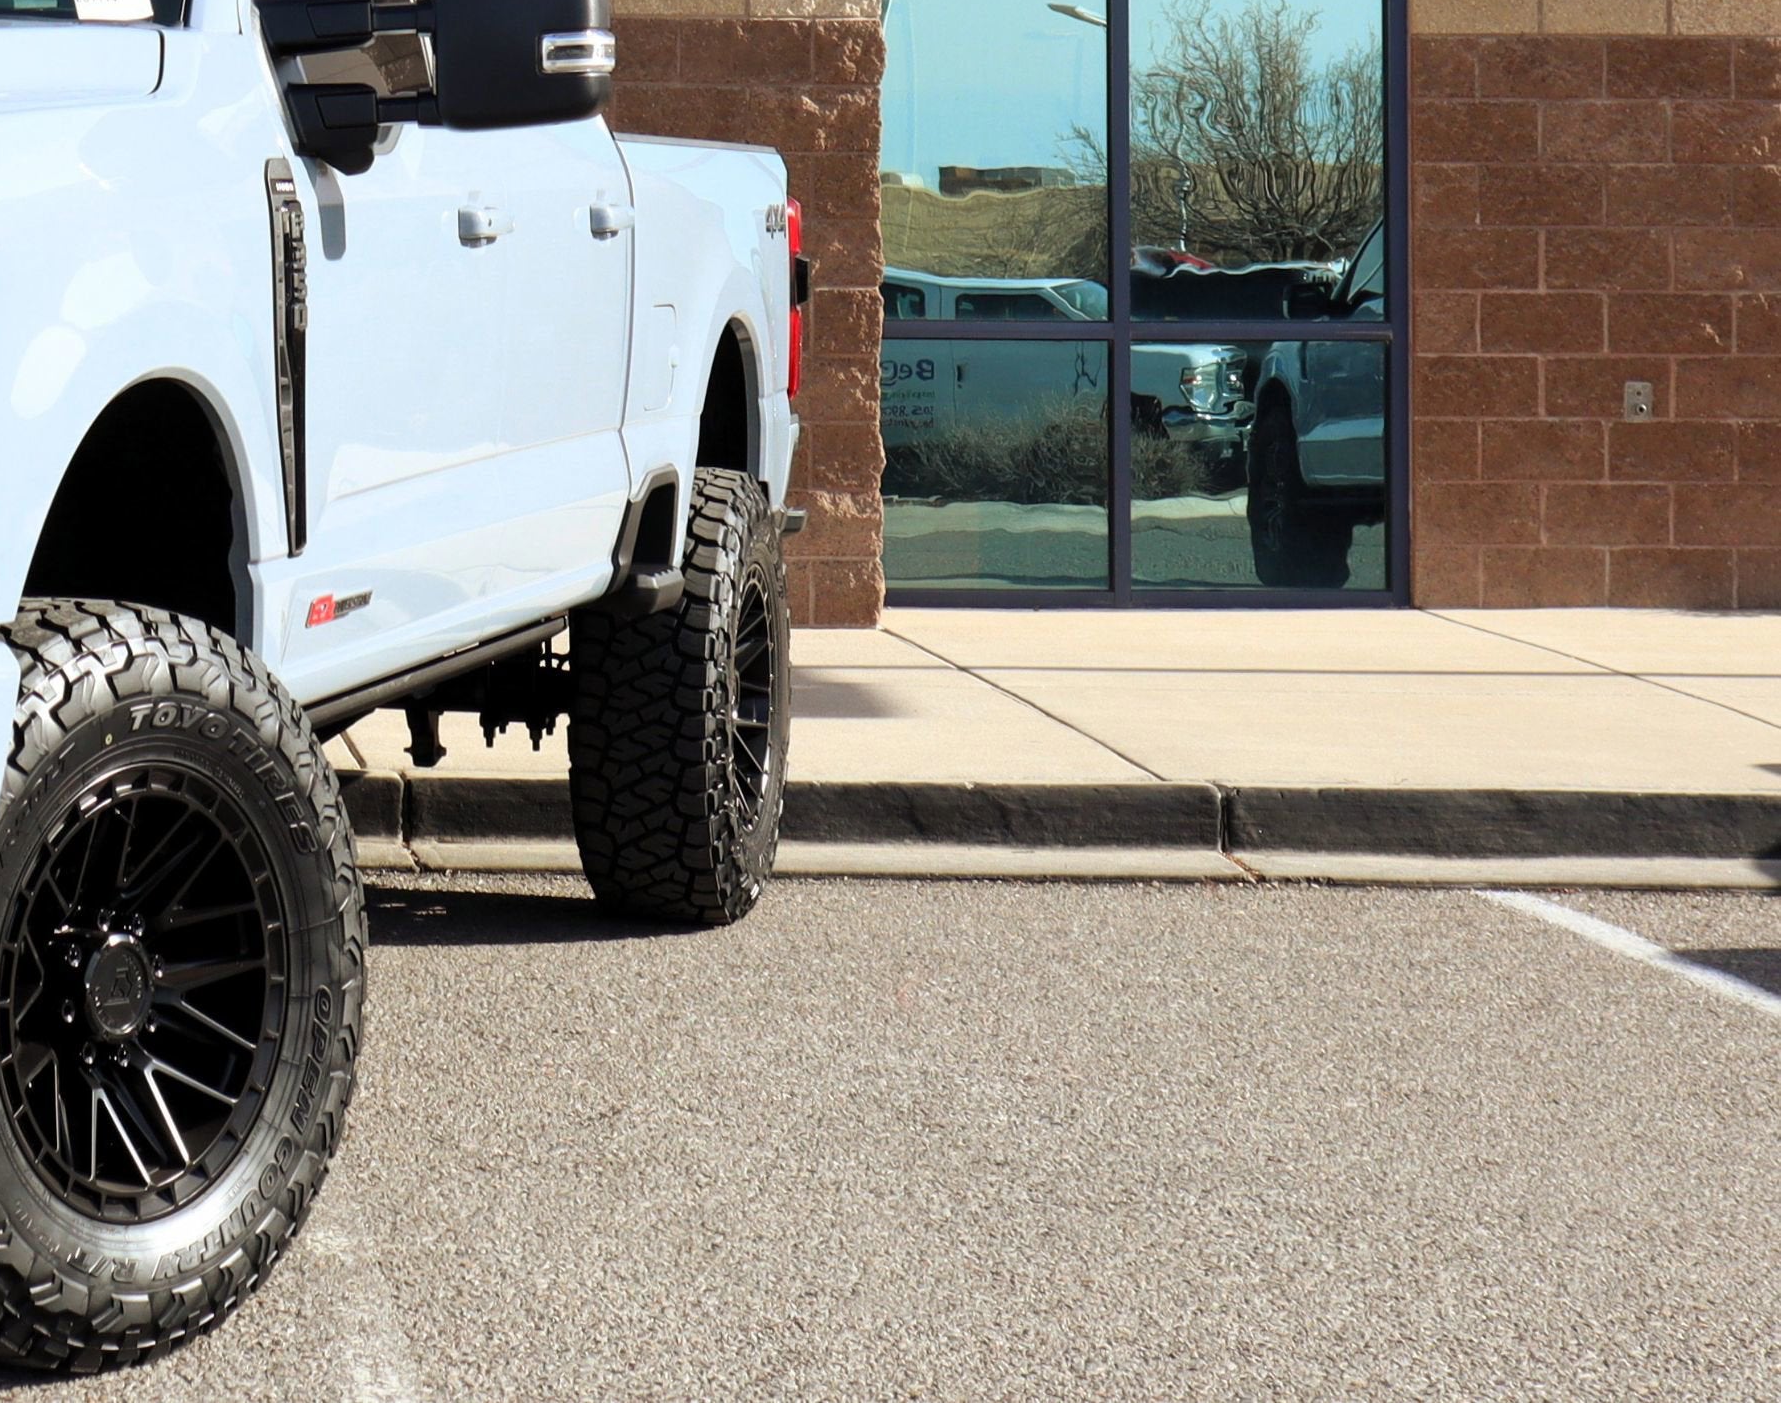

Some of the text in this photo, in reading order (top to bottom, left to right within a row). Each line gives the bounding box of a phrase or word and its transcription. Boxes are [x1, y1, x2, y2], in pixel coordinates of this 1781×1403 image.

[130, 701, 230, 740] TOYO
[228, 727, 319, 854] TIRES
[290, 984, 333, 1135] OPEN
[66, 1247, 141, 1284] R/T
[151, 1133, 295, 1283] COUNTRY
